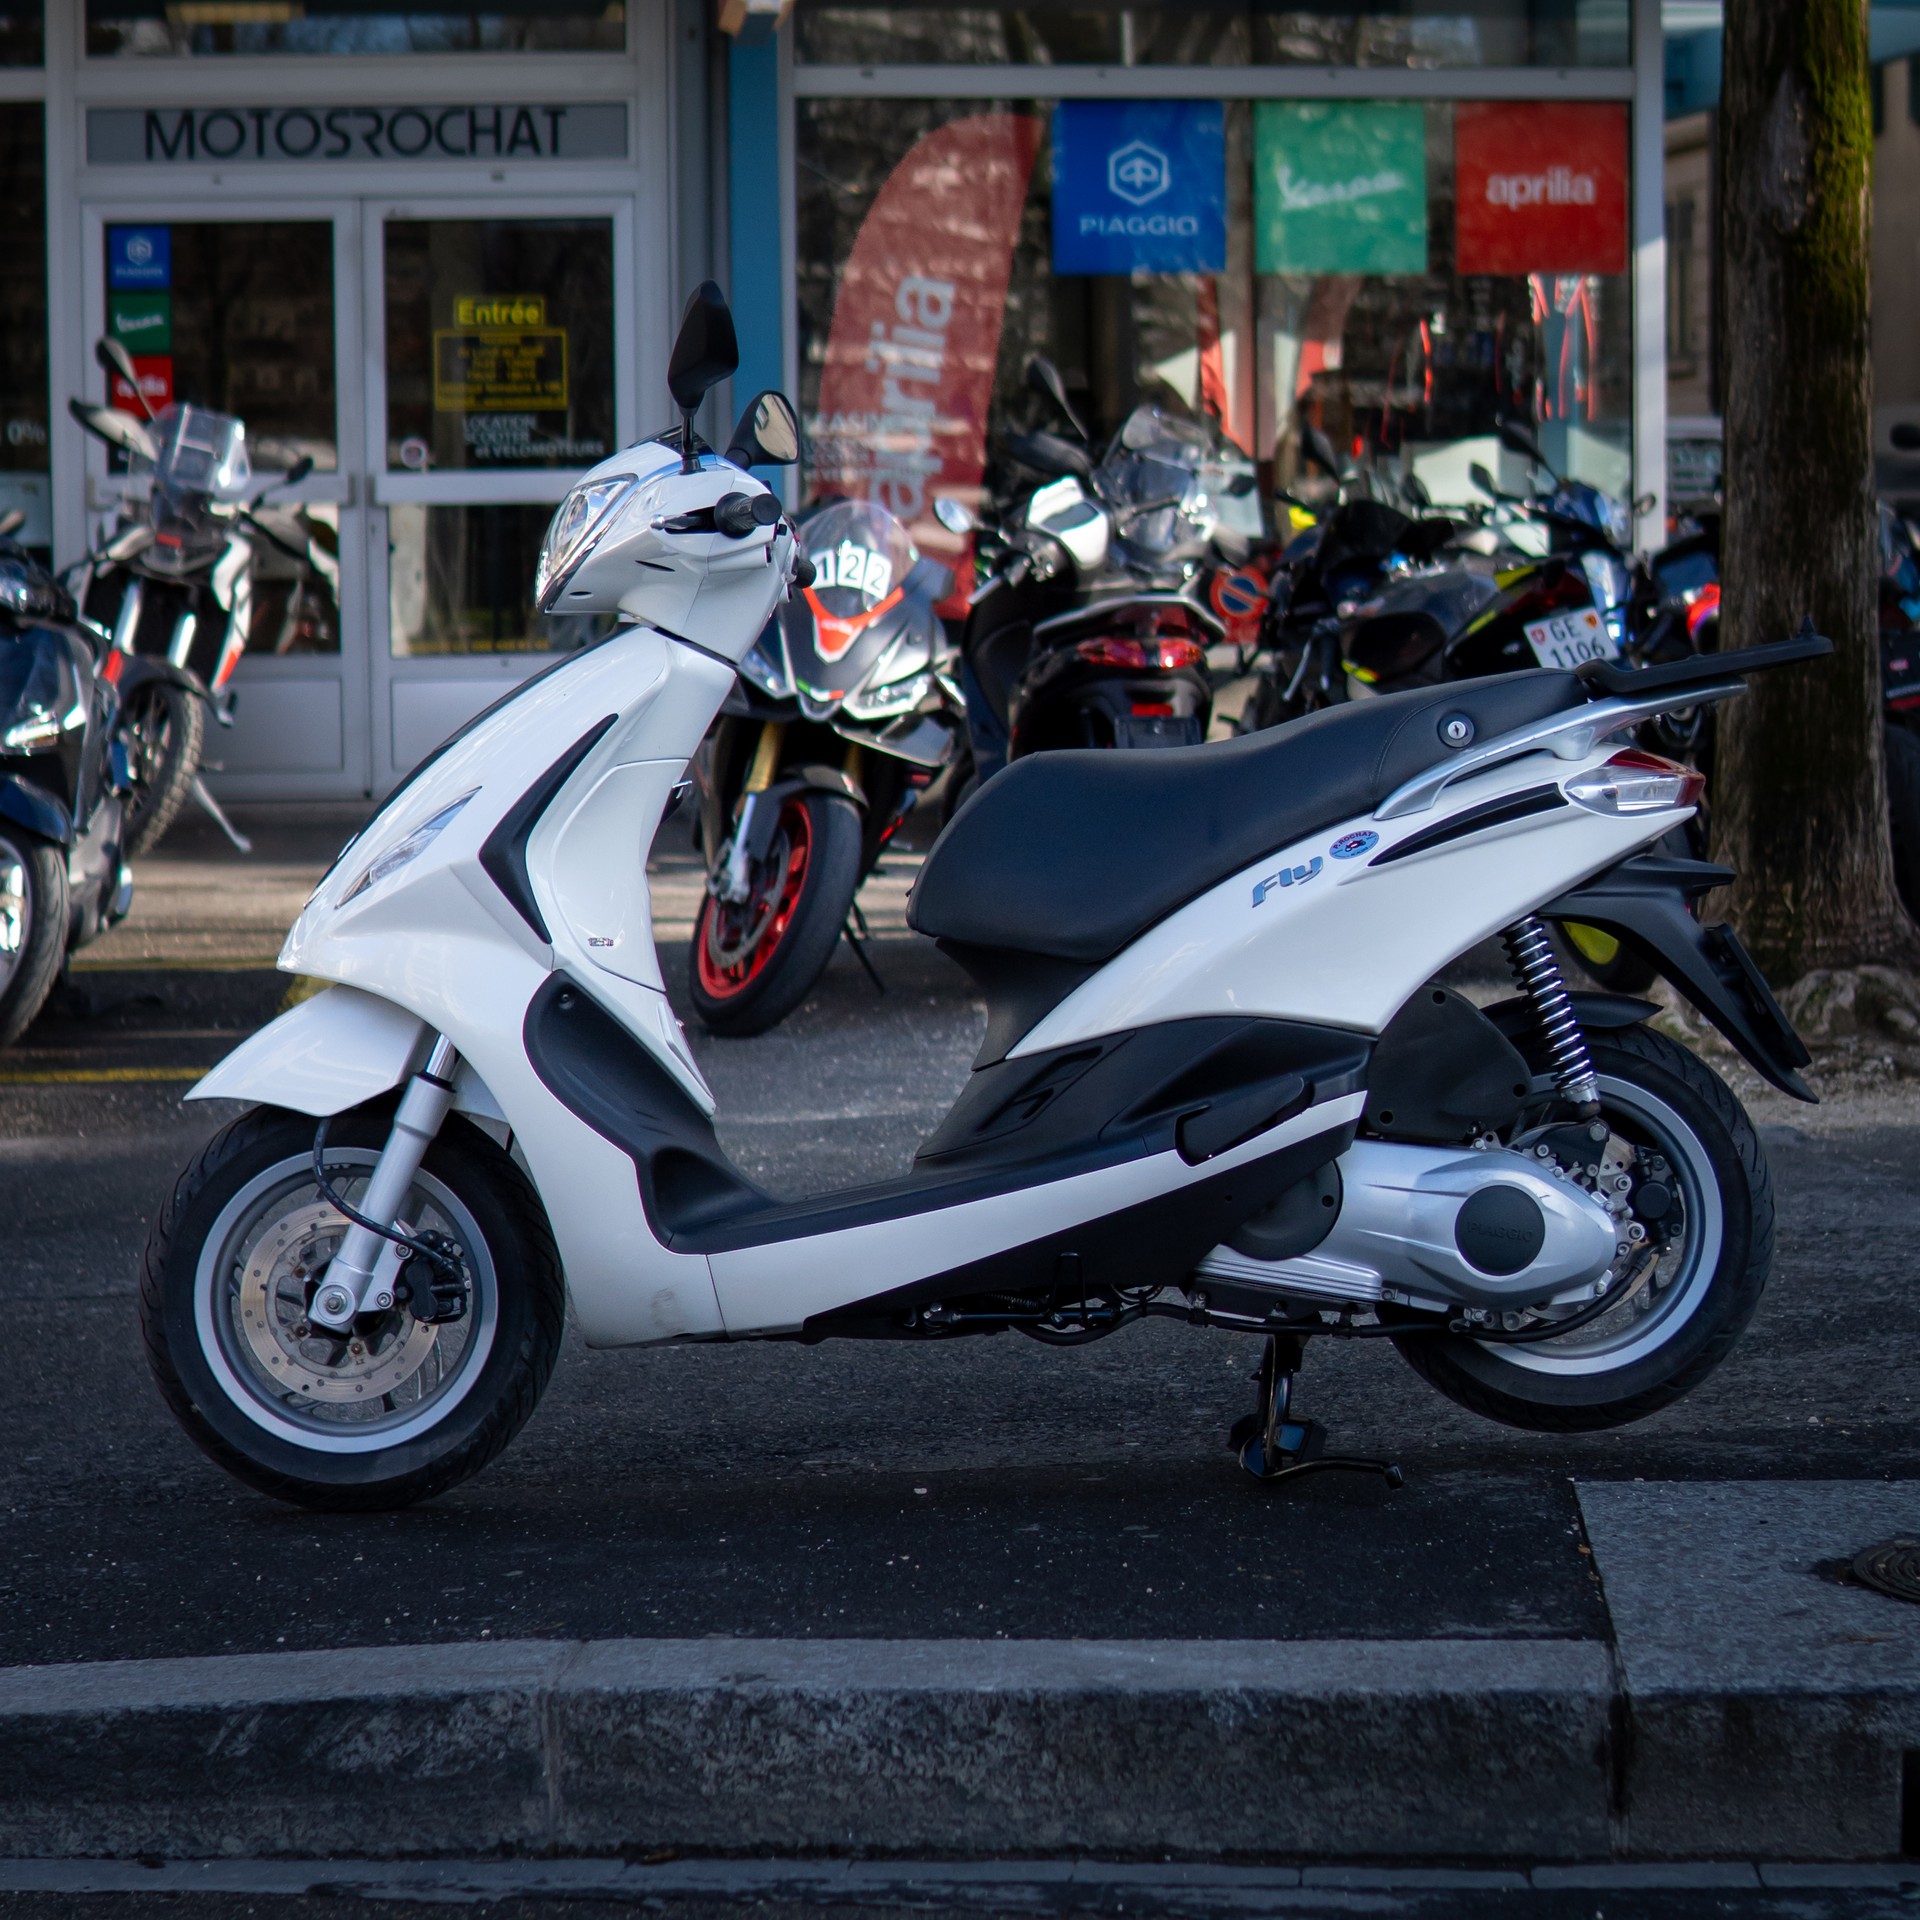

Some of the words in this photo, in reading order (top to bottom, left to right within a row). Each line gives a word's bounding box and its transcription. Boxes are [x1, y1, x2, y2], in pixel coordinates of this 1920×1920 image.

[1486, 166, 1596, 212] aprilia
[1079, 215, 1199, 236] PIAGGIO
[458, 299, 540, 326] Entrée
[866, 275, 955, 520] aprilia
[815, 553, 886, 591] 122
[1549, 615, 1581, 641] GE
[1550, 637, 1607, 669] 1106
[1251, 855, 1324, 908] Fly
[1465, 1220, 1535, 1243] PIAGGIO
